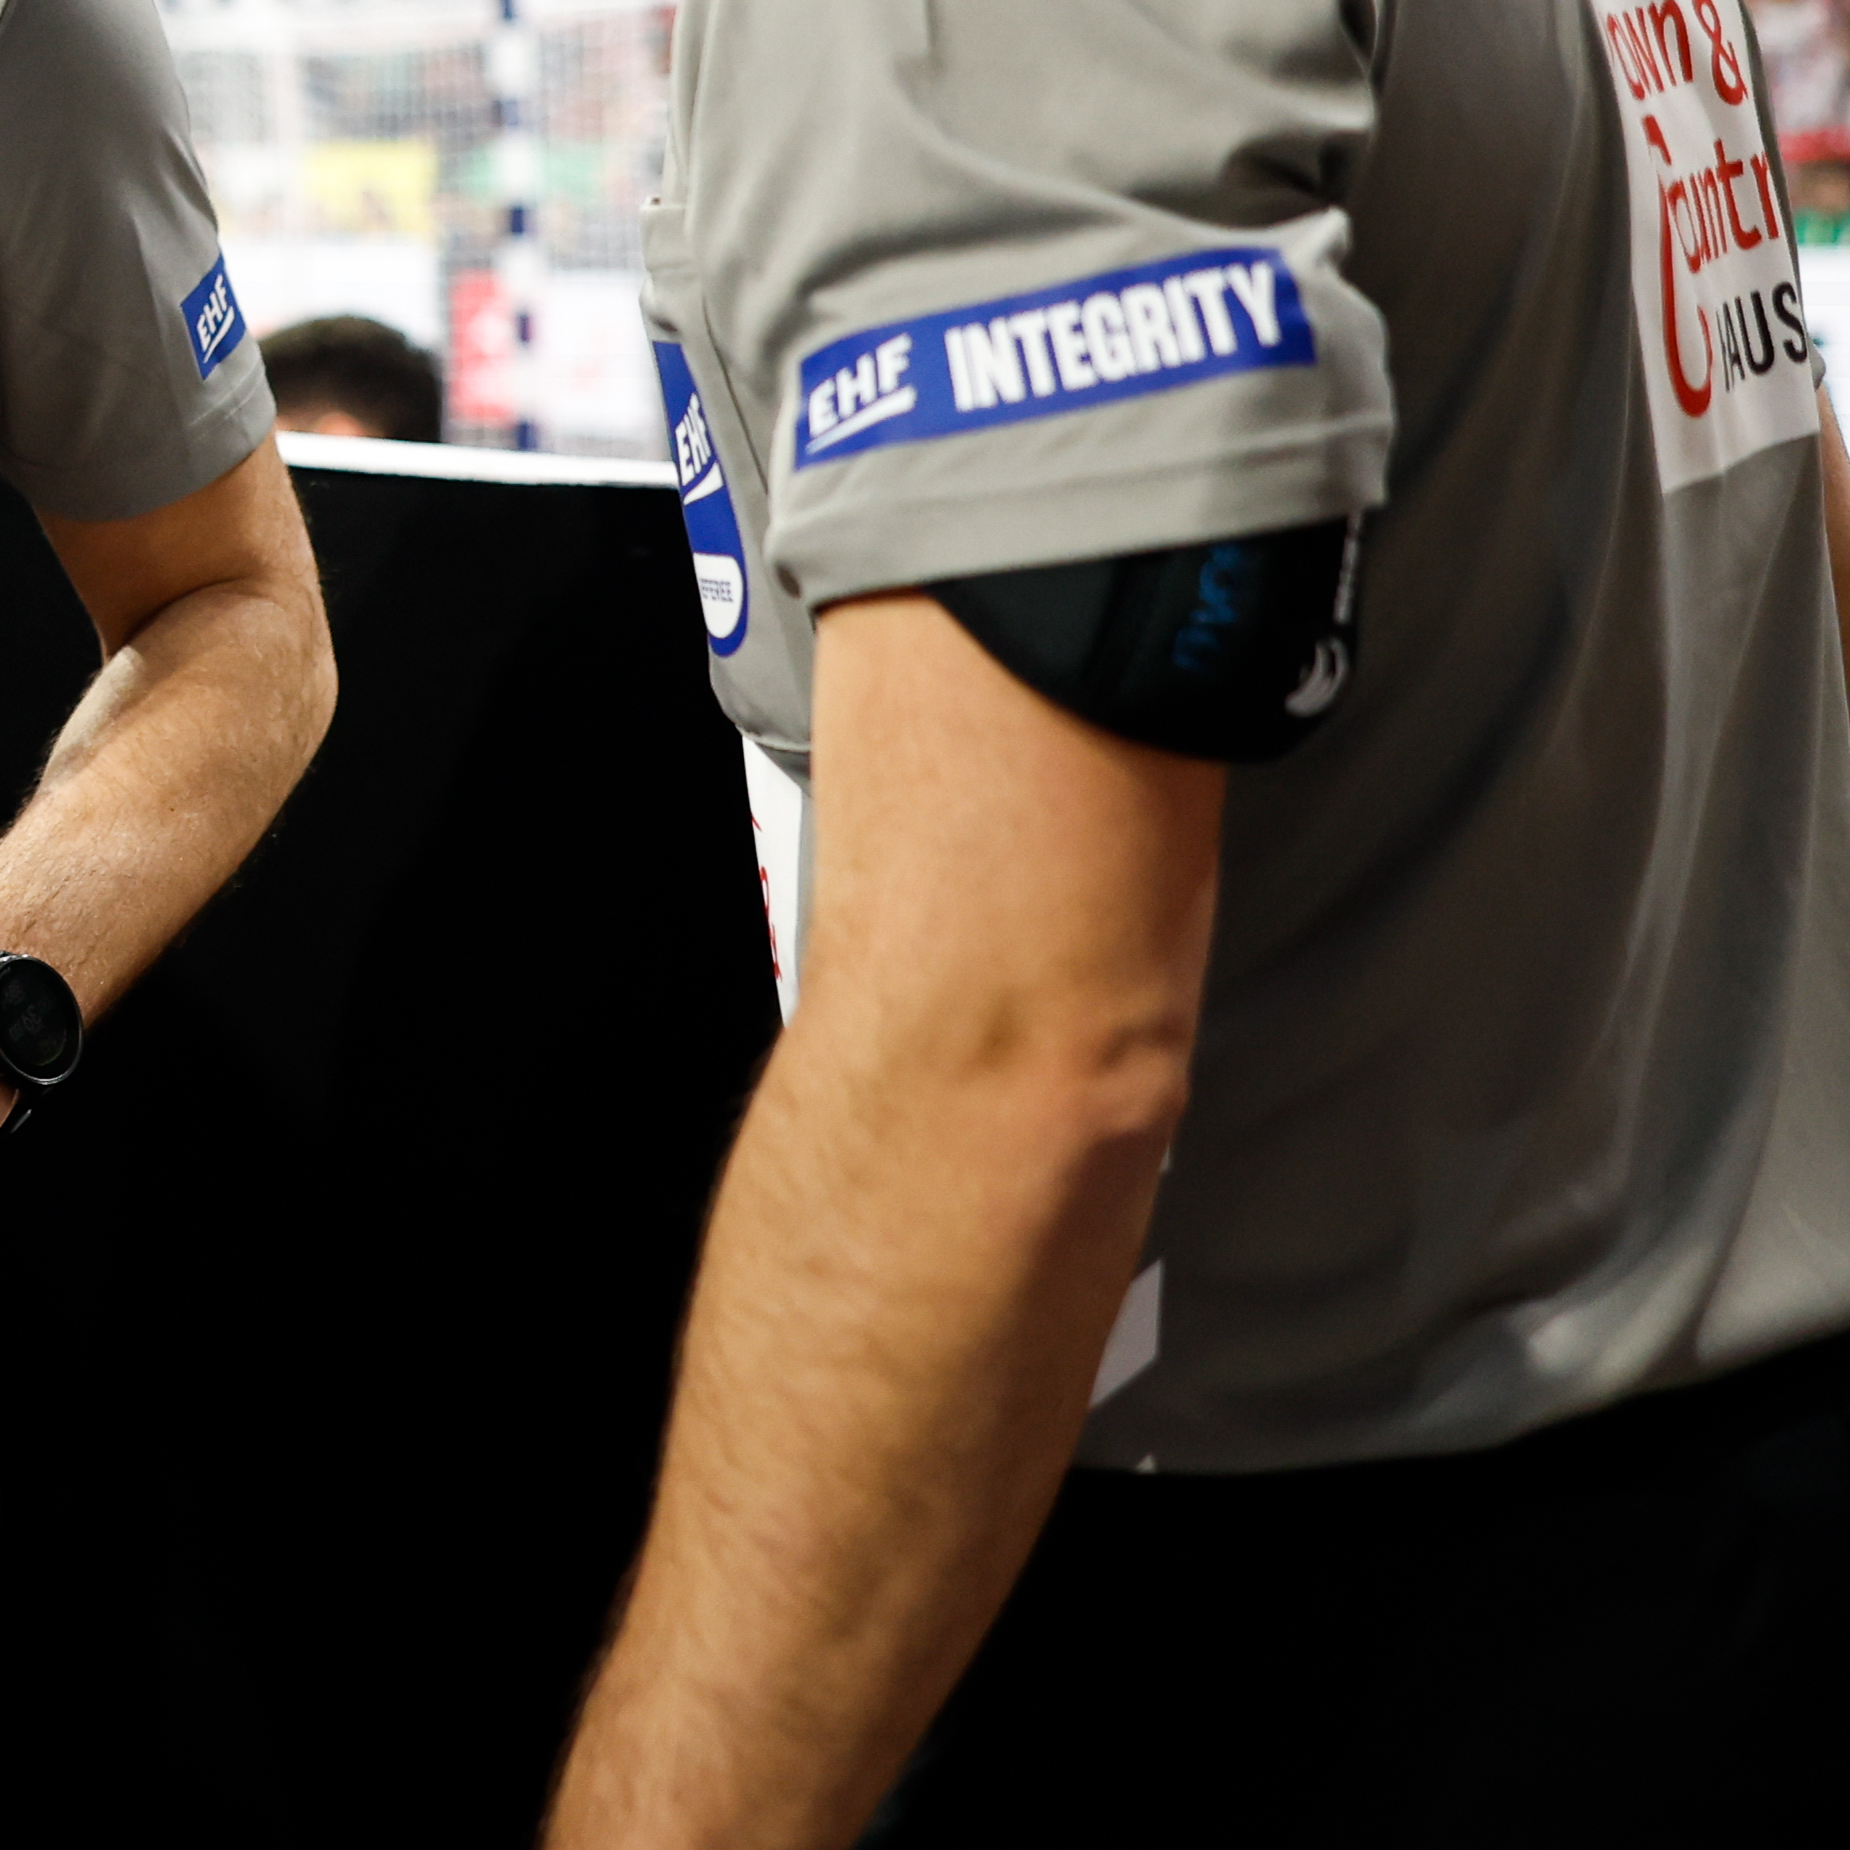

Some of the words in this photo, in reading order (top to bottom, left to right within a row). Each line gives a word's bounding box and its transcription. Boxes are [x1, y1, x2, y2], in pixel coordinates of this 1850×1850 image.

[196, 273, 228, 353] EHF
[807, 332, 913, 438] EHF
[943, 260, 1283, 413] INTEGRITY
[1641, 113, 1781, 418] Countr
